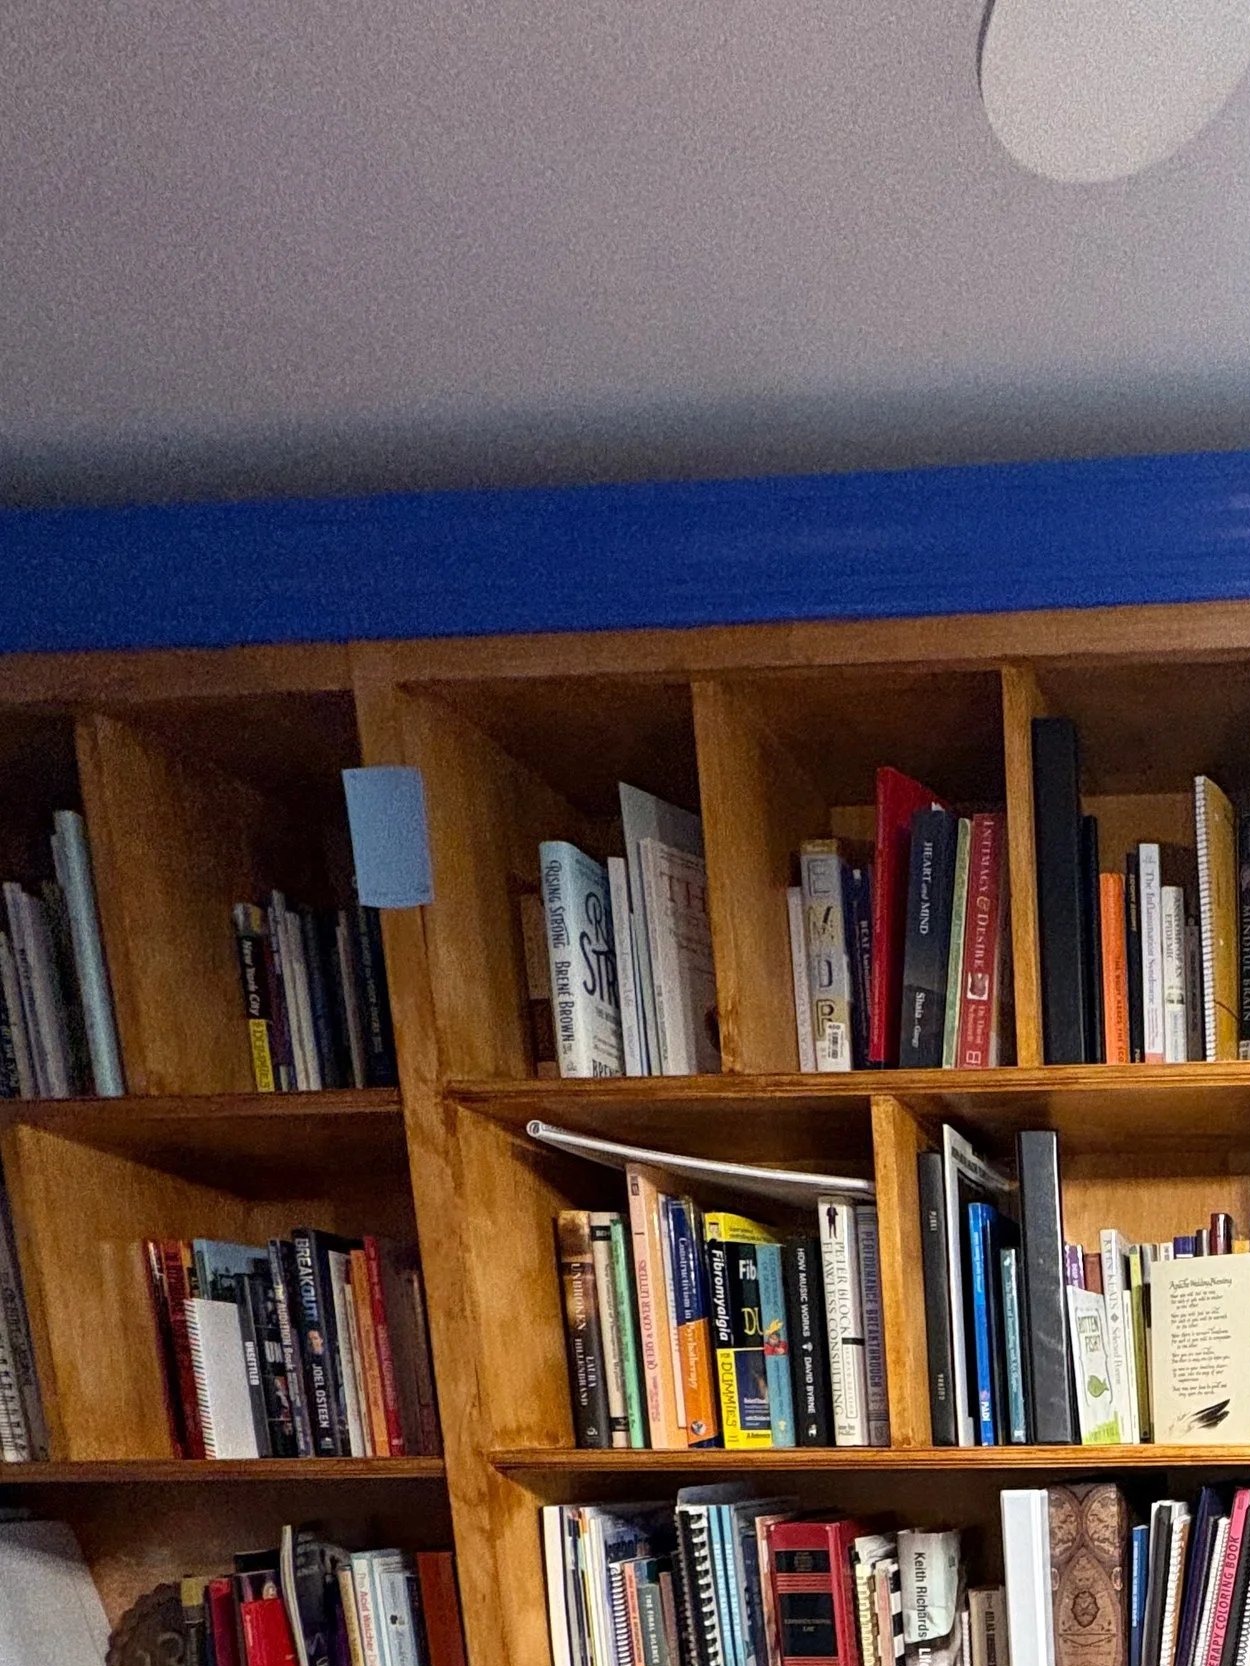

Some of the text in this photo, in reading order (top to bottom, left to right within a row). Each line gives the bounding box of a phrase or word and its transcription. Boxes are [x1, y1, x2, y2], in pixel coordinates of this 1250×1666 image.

[922, 842, 933, 881] HEART
[1144, 871, 1155, 889] The
[545, 860, 570, 949] RISING STRONG
[919, 902, 930, 935] MIND
[974, 821, 994, 968] INTIMACY & DESIRE
[1146, 891, 1158, 956] Inflammation
[1165, 914, 1173, 962] EPIDEMIC
[241, 940, 260, 1016] New York City
[555, 961, 574, 1041] BRENÉ BROWN
[914, 992, 925, 1018] Shaia
[1146, 958, 1157, 1004] Syndrome
[570, 1263, 586, 1331] UNBROKEN
[638, 1258, 651, 1300] LETTERS
[711, 1250, 730, 1341] Fibromyalgia
[797, 1248, 811, 1337] HOW MUSIC WORKS
[835, 1242, 851, 1336] PETER BLOCK
[861, 1231, 882, 1387] PERFORMANCE BREAKTHROUGH
[1108, 1274, 1119, 1311] KEATS
[275, 1303, 294, 1370] AUDITION Book
[641, 1300, 653, 1331] COVER
[678, 1237, 699, 1389] Constructivism in Psychotherapy
[822, 1241, 844, 1415] FLAWLESS CONSULTING
[244, 1341, 260, 1386] UNSETTLED
[312, 1364, 330, 1428] JOEL OSTEEN
[574, 1338, 589, 1406] HILLENBRAND
[586, 1356, 597, 1389] LAURA
[721, 1361, 738, 1427] DUMMIES
[804, 1357, 816, 1414] DAVID BYRNE
[980, 1401, 991, 1421] PADI
[360, 1591, 368, 1612] Acid
[914, 1552, 930, 1638] Keith Richards
[1214, 1566, 1237, 1622] COLORING
[1226, 1536, 1240, 1566] BOOK
[361, 1614, 373, 1651] Watcher
[645, 1594, 660, 1664] THE FINAL SILENCE
[985, 1611, 996, 1632] ATLAS
